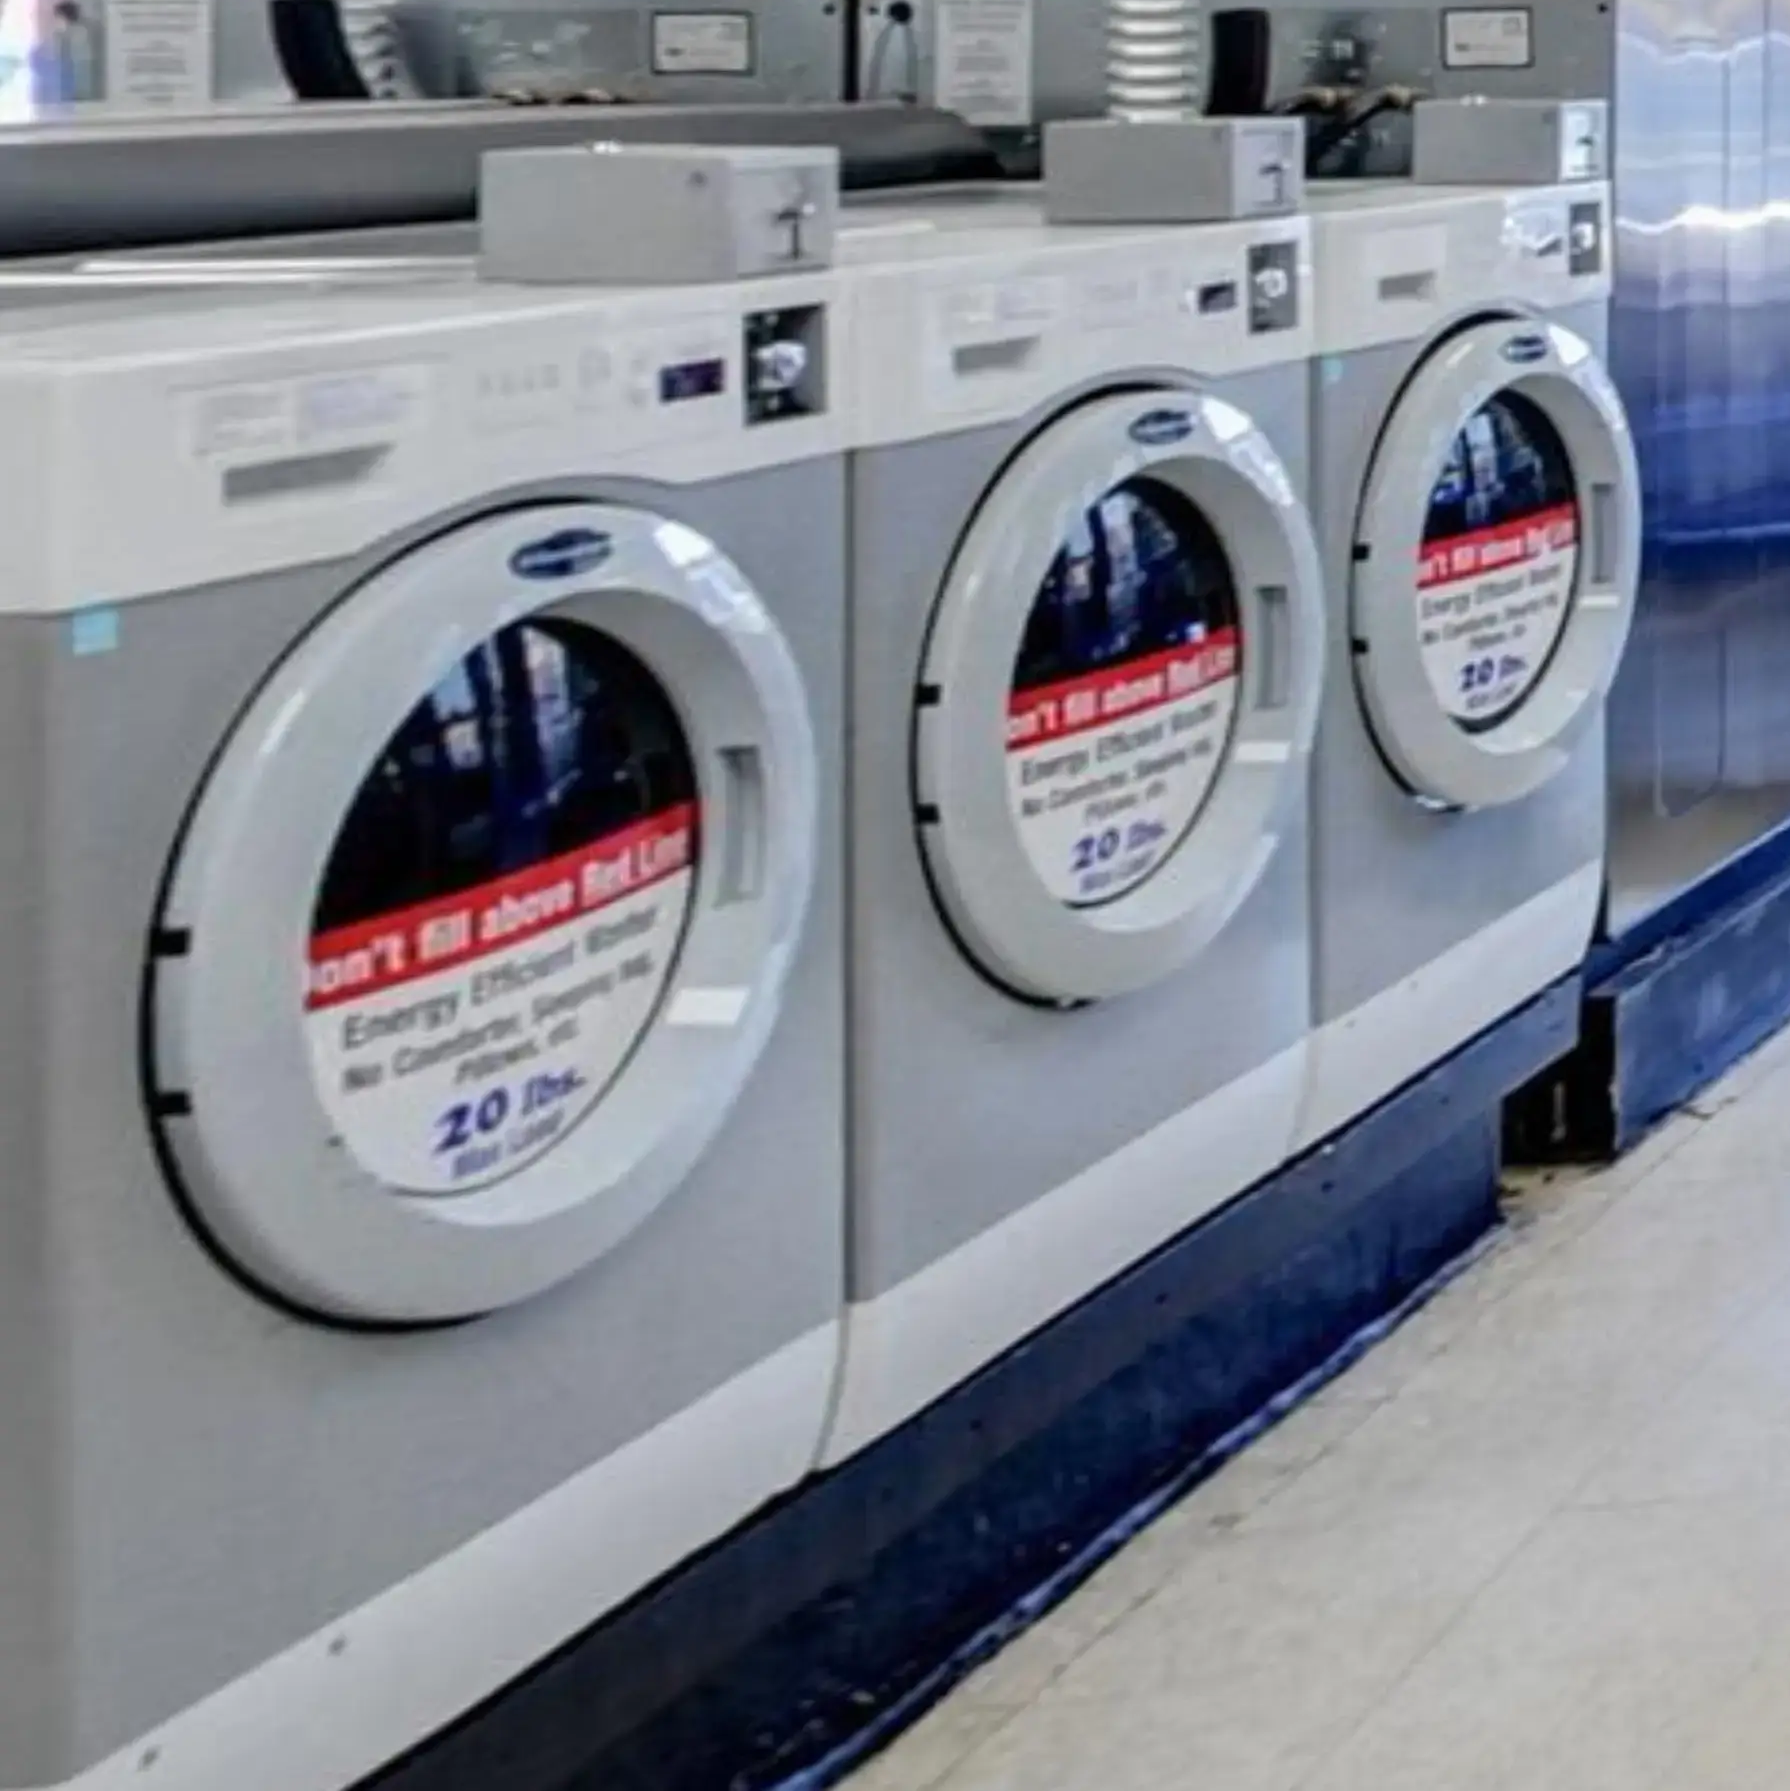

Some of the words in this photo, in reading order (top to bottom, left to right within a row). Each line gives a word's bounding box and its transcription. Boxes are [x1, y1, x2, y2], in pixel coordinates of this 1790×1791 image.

[1009, 697, 1058, 741] on't
[1022, 747, 1090, 787] Energy
[1073, 827, 1120, 871] 20
[418, 907, 473, 961] fill
[480, 877, 575, 941] above
[580, 845, 633, 909] Red
[343, 989, 461, 1050] Energy
[470, 937, 576, 1006] Efficient
[433, 1086, 510, 1153] 20
